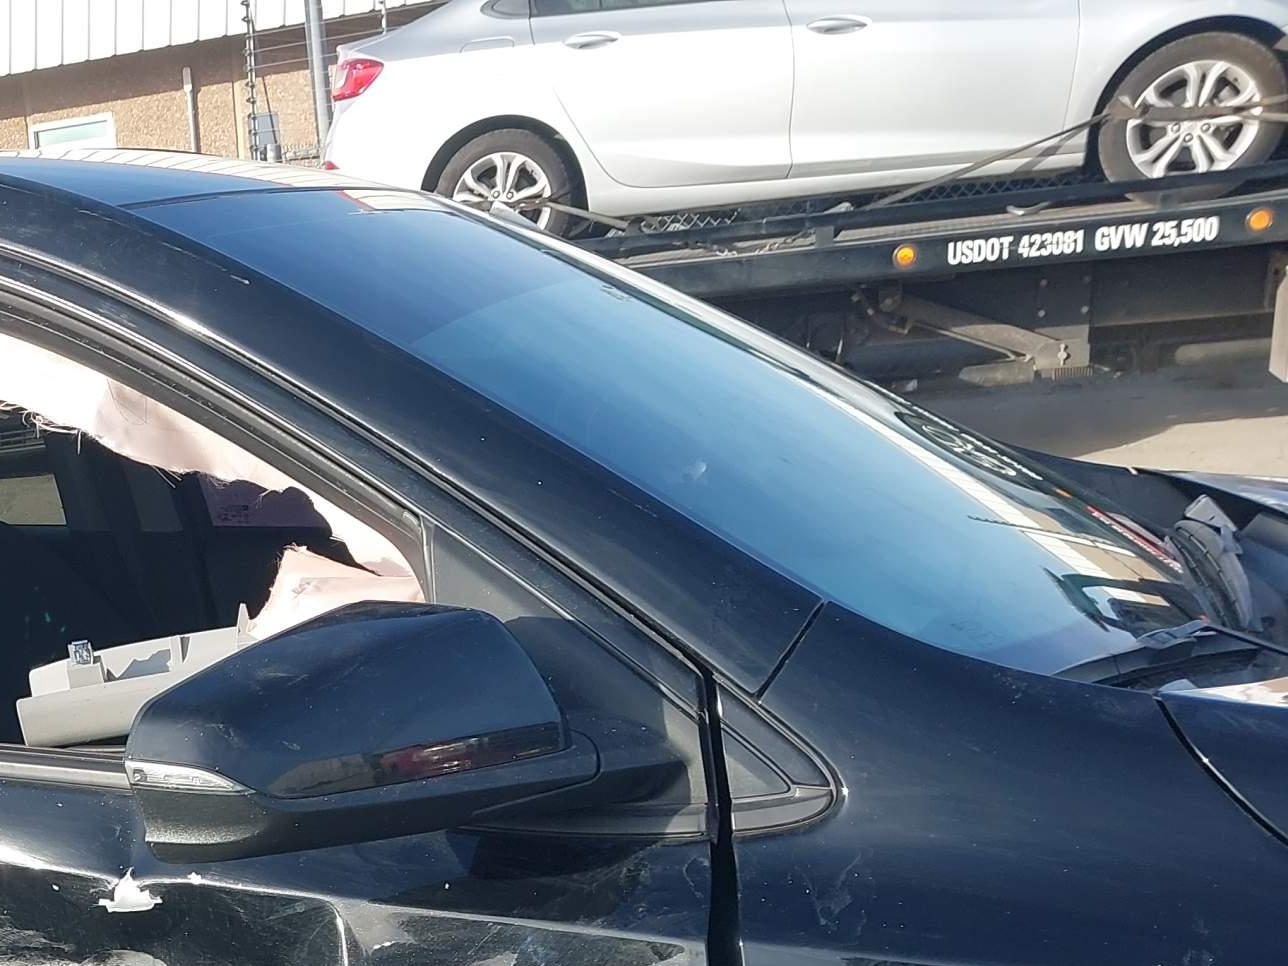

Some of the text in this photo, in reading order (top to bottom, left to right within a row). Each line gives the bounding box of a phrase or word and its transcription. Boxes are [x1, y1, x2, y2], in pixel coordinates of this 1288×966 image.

[947, 216, 1221, 265] USDOT 423081 GVW 25,500
